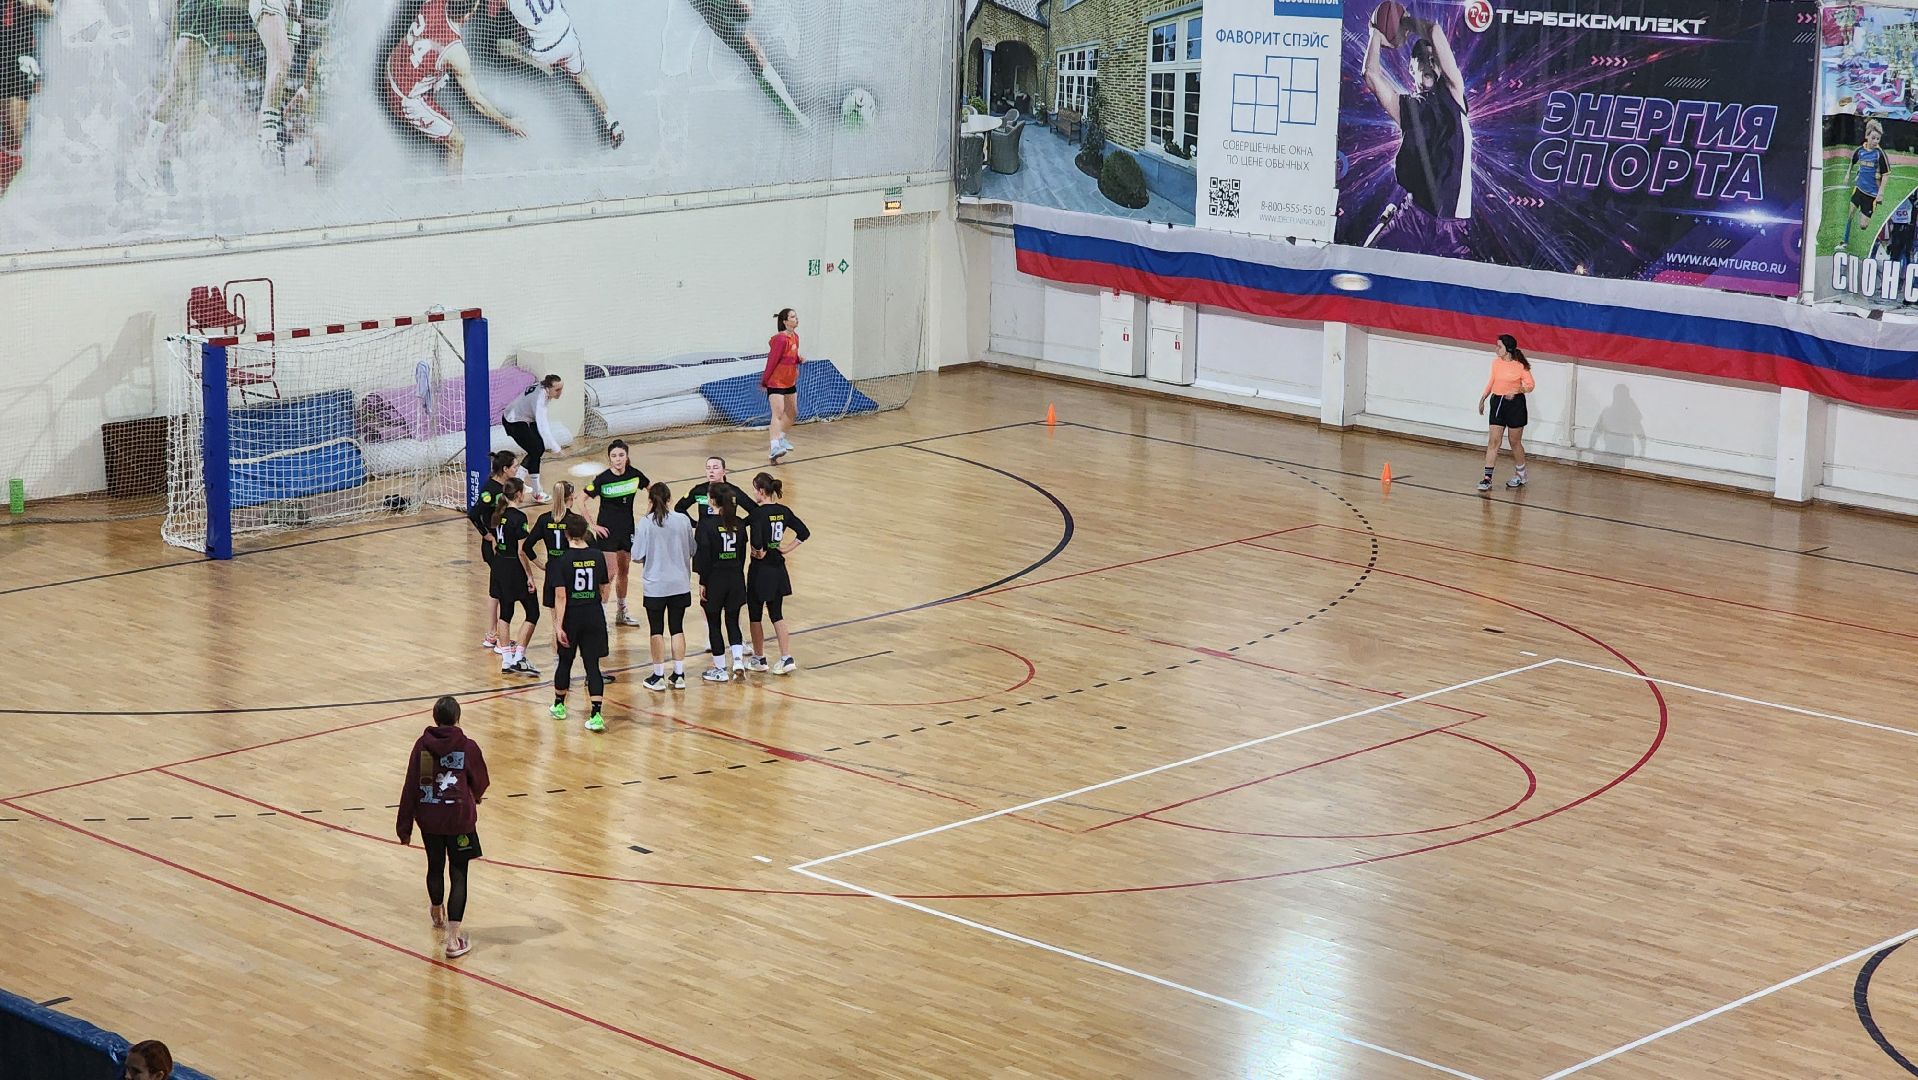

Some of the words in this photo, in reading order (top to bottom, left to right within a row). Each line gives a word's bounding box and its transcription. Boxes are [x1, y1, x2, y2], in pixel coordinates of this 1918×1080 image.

[1496, 9, 1706, 35] ТУРБОКОМПЛЕКТ
[1215, 28, 1280, 47] ФАВОРИТ
[1282, 31, 1330, 49] СПЭЙС
[1540, 90, 1778, 151] ЭНЕРГИЯ
[1288, 144, 1314, 157] ОКНА
[1226, 154, 1239, 165] ПО
[1241, 155, 1263, 168] ЦЕНЕ
[1265, 158, 1310, 171] ОБЫЧНЫХ
[1529, 137, 1764, 201] СПОРТА
[1666, 252, 1787, 275] WWW.KAMTURBO.RU
[553, 529, 561, 550] 1
[720, 532, 736, 552] 12
[770, 521, 784, 542] 18
[574, 568, 594, 592] 61
